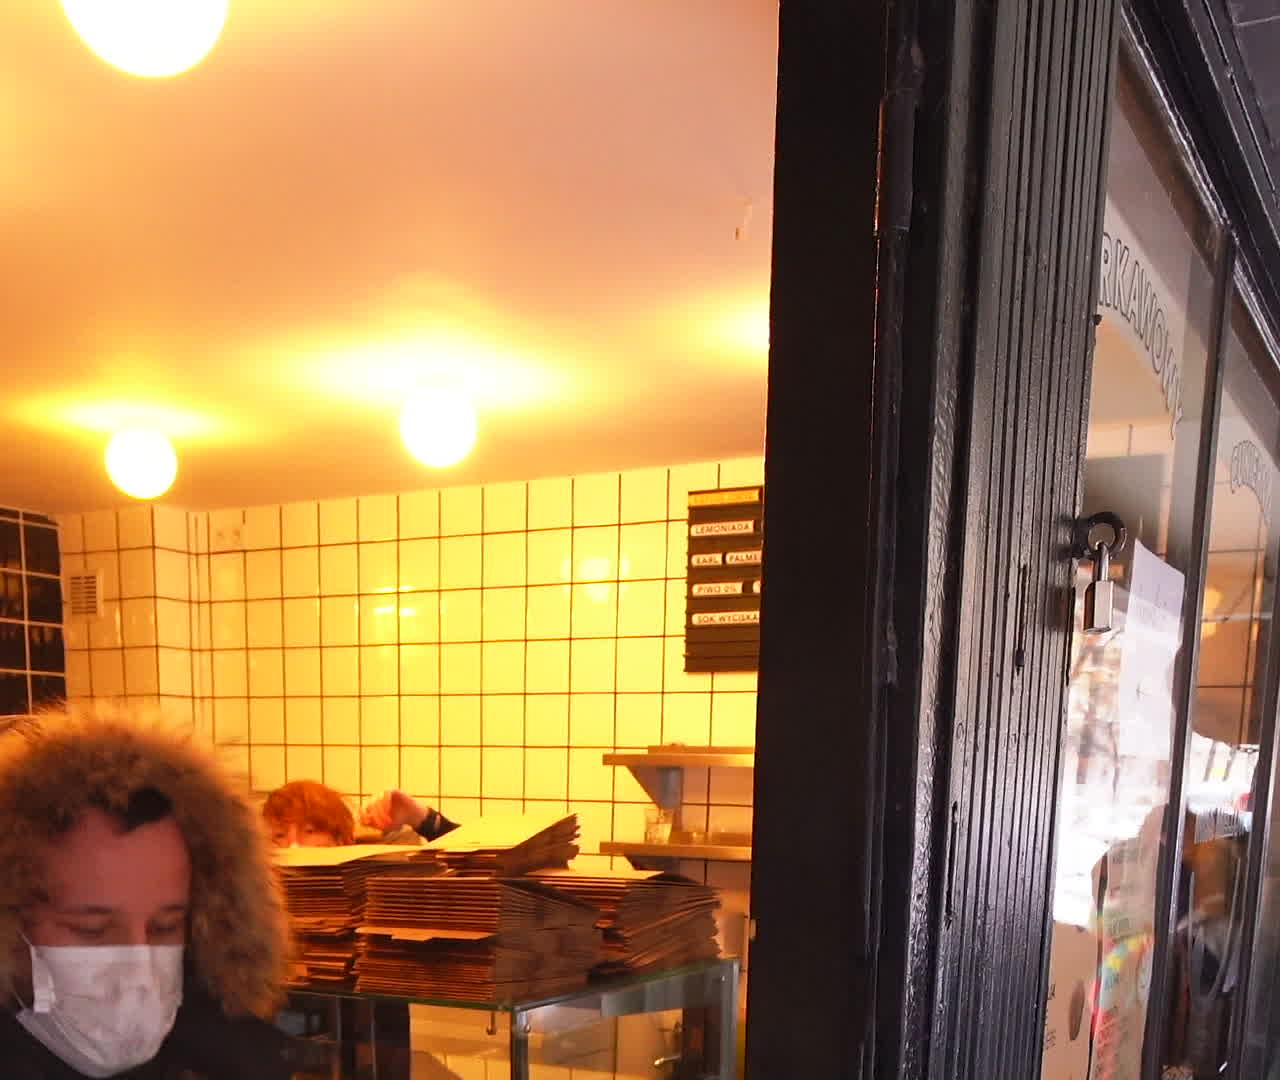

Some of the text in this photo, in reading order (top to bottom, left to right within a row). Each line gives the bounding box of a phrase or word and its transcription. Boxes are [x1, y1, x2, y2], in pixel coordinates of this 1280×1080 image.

[695, 523, 750, 535] LEMONIADA
[697, 585, 721, 594] PIWO
[697, 615, 716, 624] SOK
